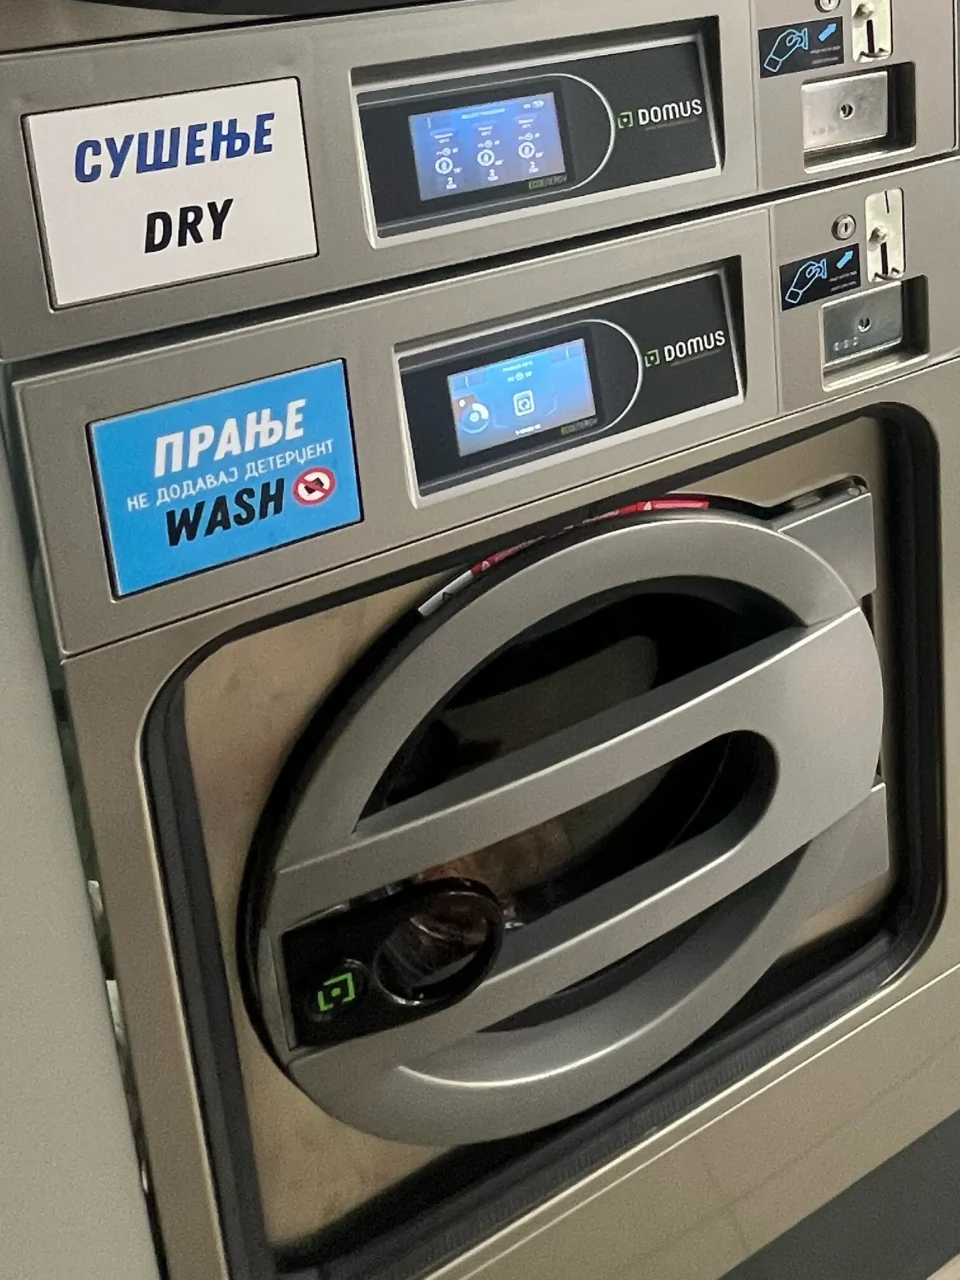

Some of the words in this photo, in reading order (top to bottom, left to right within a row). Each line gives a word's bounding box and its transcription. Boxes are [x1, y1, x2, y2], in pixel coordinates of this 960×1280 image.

[637, 98, 703, 126] DOMUS
[74, 112, 275, 183] СУШЕЊЕ
[144, 198, 234, 253] DRY
[663, 329, 726, 364] DOMUS
[154, 398, 307, 478] ПРАЊЕ
[127, 494, 149, 512] НЕ
[156, 467, 239, 507] ДОДАВАЈ
[166, 477, 285, 547] WASH
